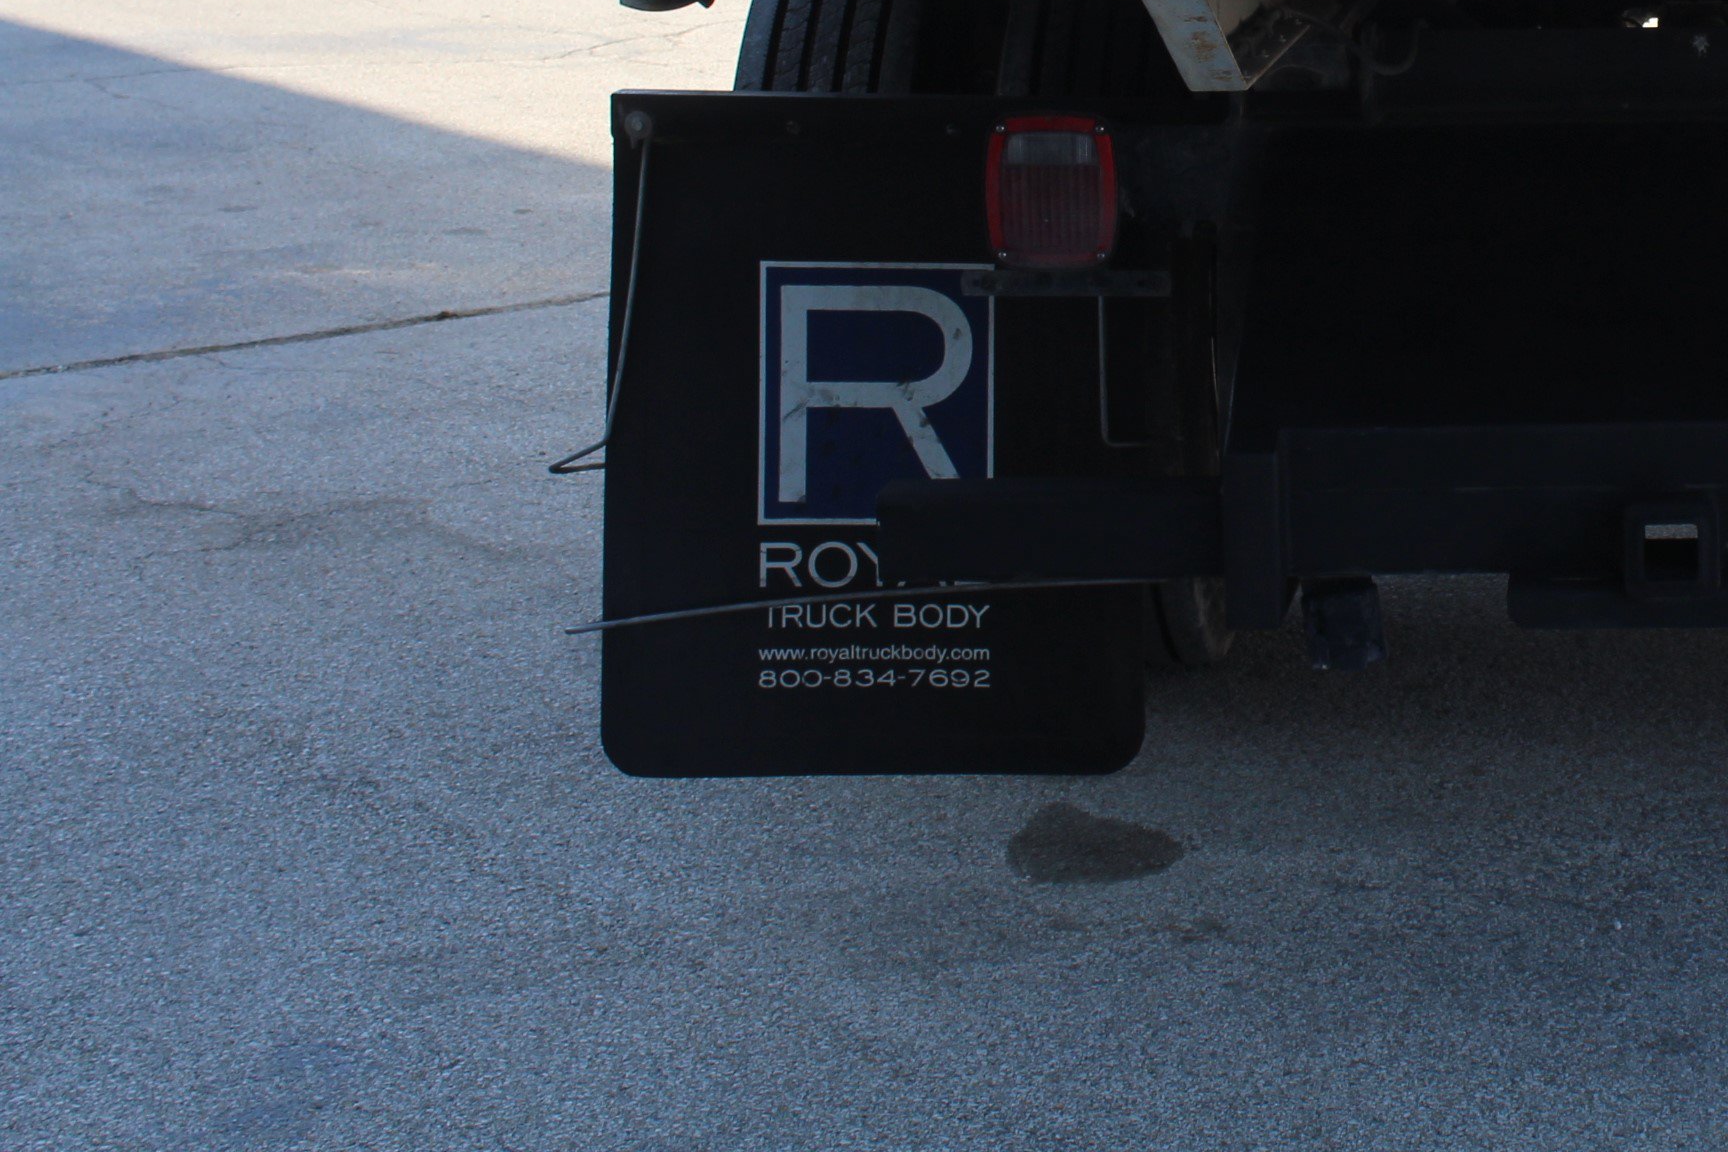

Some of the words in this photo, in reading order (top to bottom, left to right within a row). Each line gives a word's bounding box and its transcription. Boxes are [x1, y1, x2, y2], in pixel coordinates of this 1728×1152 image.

[893, 604, 991, 629] BODY
[758, 645, 991, 664] www.royaltruckbody.com
[758, 669, 991, 688] 800-834-7692
